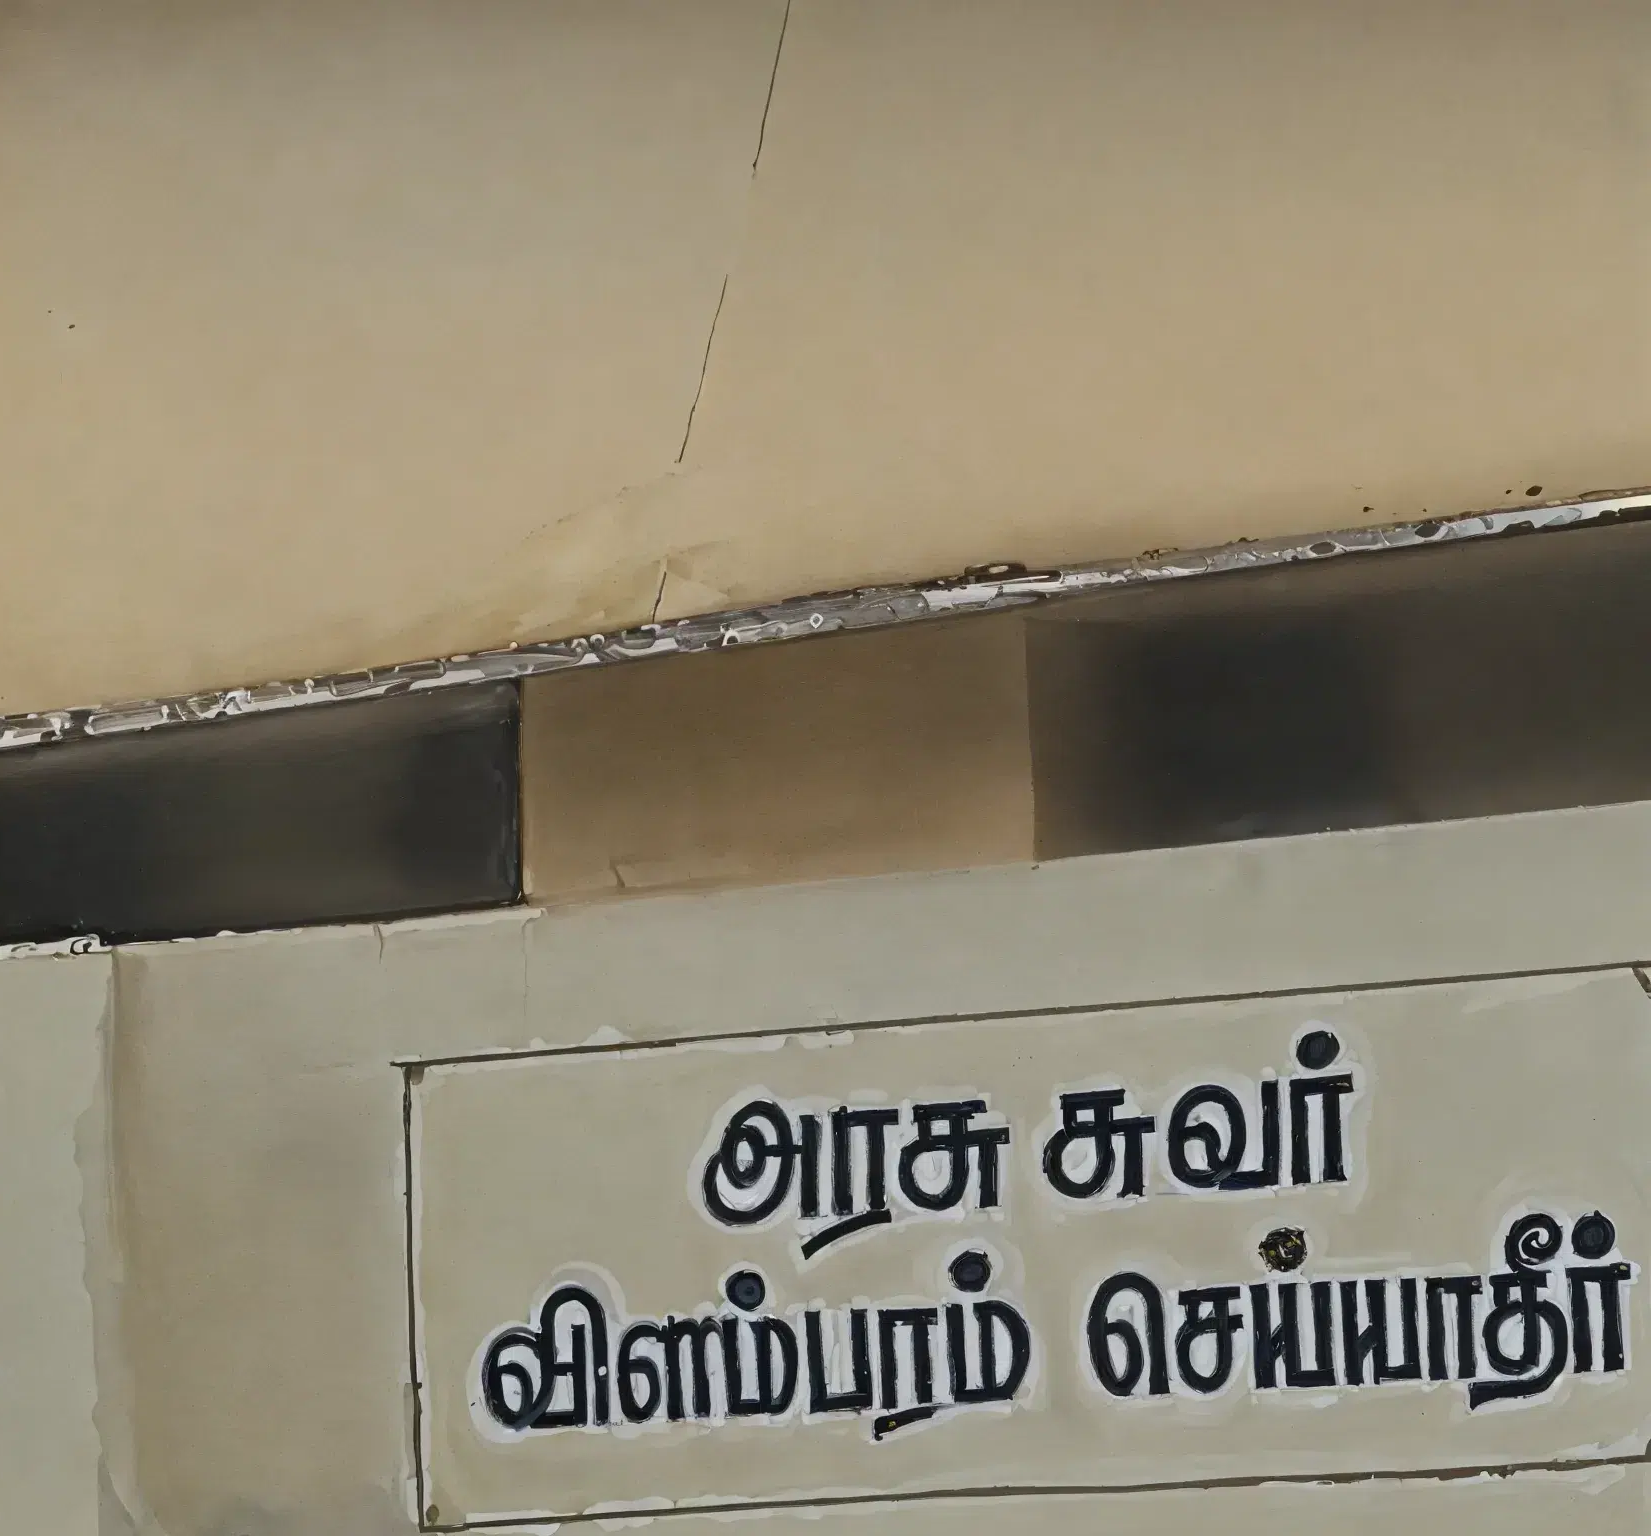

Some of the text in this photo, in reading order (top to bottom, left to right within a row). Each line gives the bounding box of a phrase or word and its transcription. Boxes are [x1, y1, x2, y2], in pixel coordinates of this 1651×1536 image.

[703, 1030, 1355, 1260] அரசு சுவர்
[481, 1209, 1632, 1442] விளம்பரம் செய்யாதீர்
